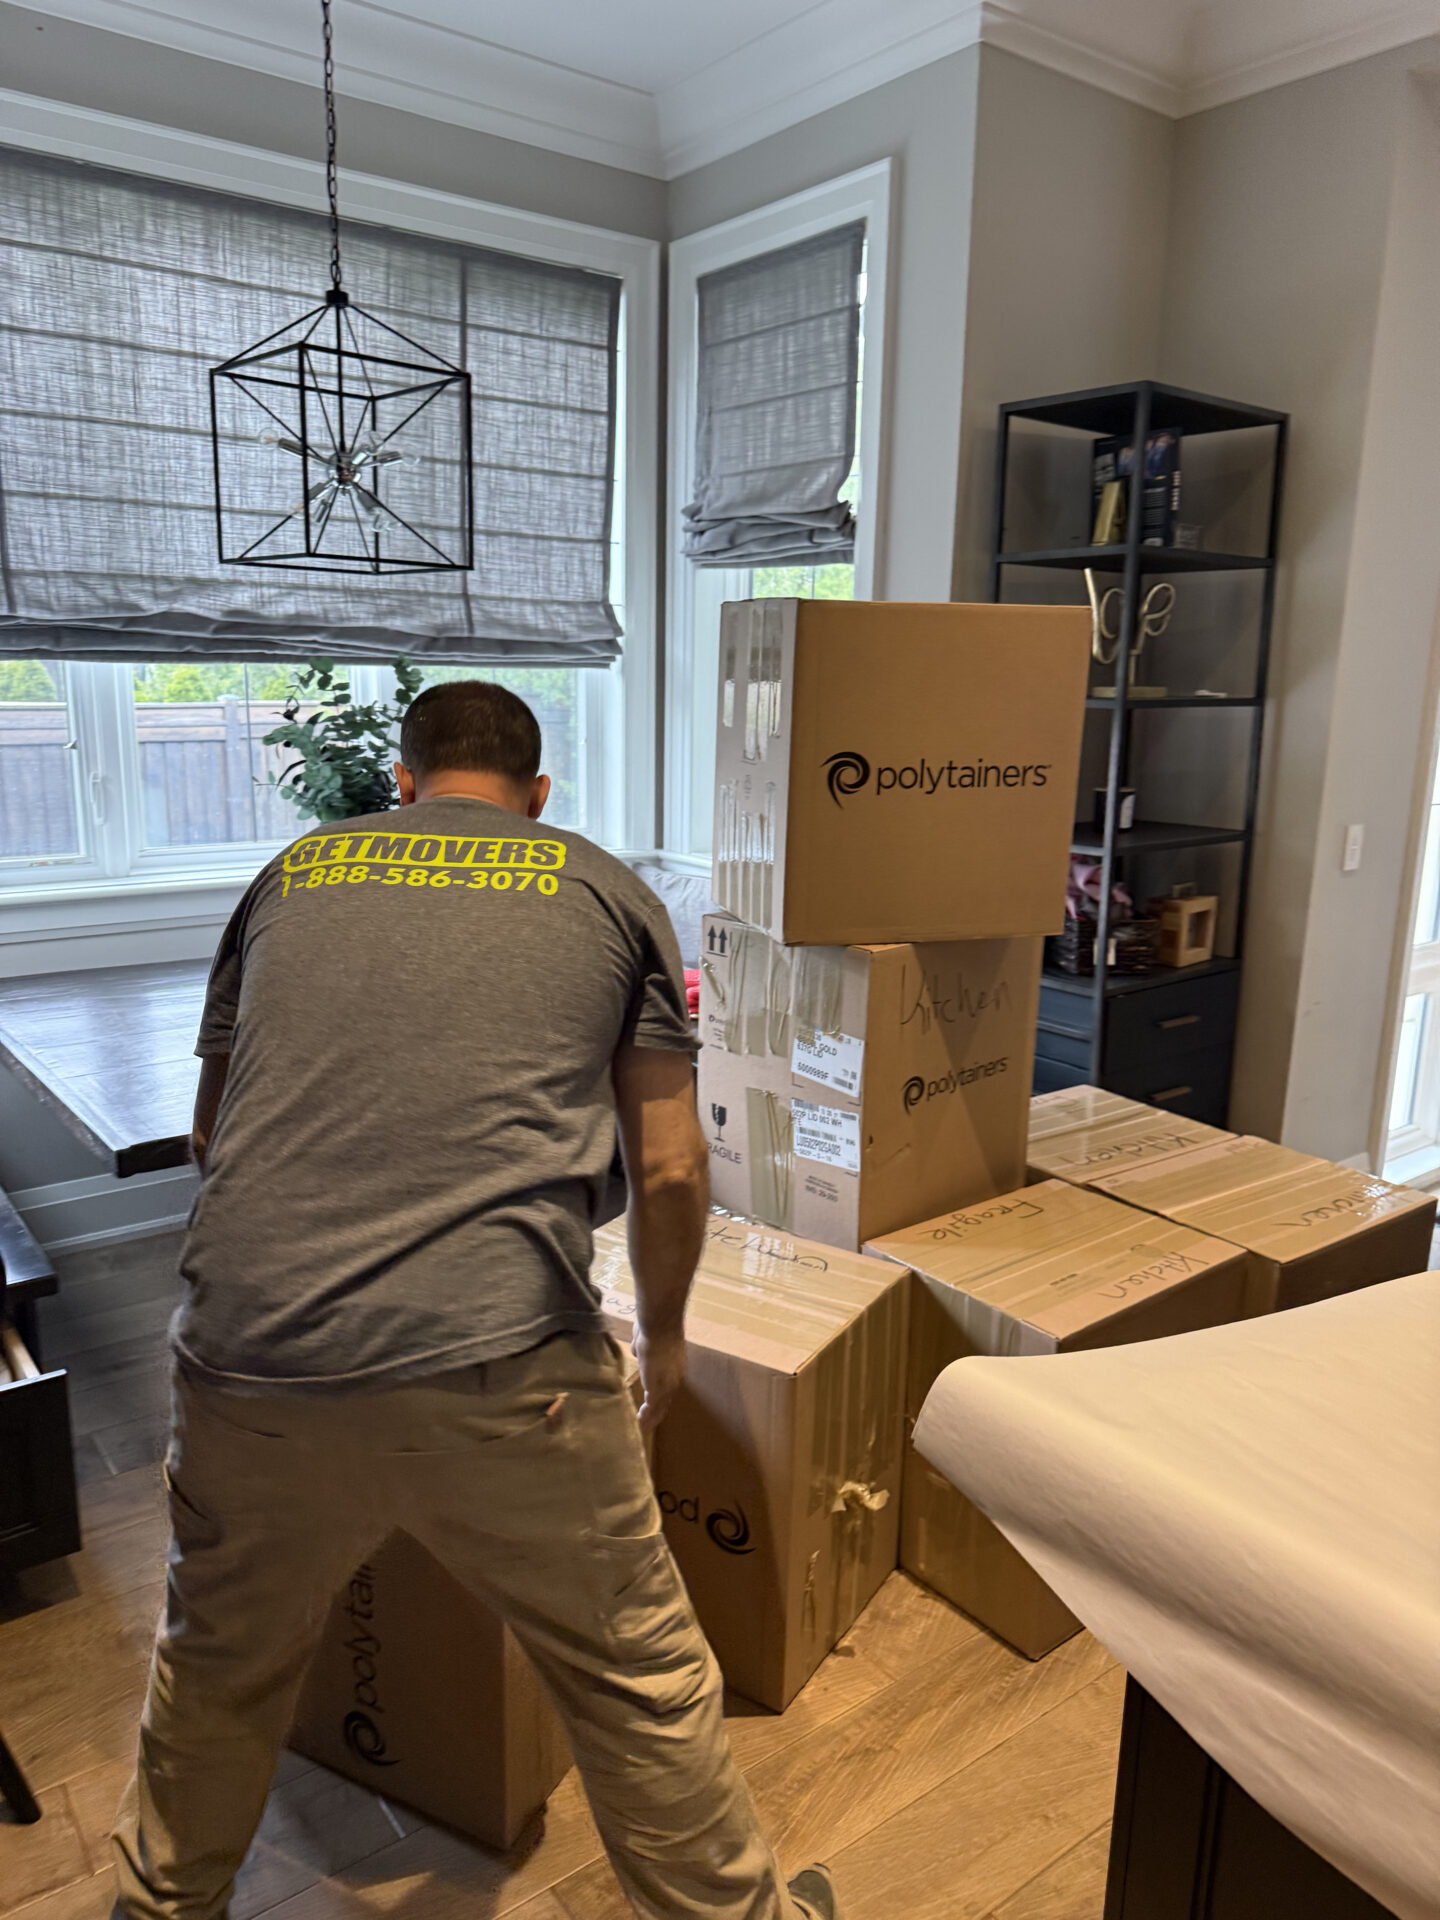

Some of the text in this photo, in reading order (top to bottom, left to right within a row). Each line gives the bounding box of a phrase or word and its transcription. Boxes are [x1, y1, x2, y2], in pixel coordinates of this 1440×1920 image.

[876, 758, 1048, 796] polytainers
[284, 833, 566, 870] GETMOVERS
[281, 865, 559, 898] 1-888-586-3070
[926, 1056, 1009, 1102] polytainers
[706, 1142, 742, 1165] RAGILE
[1096, 1250, 1211, 1300] Kitchen
